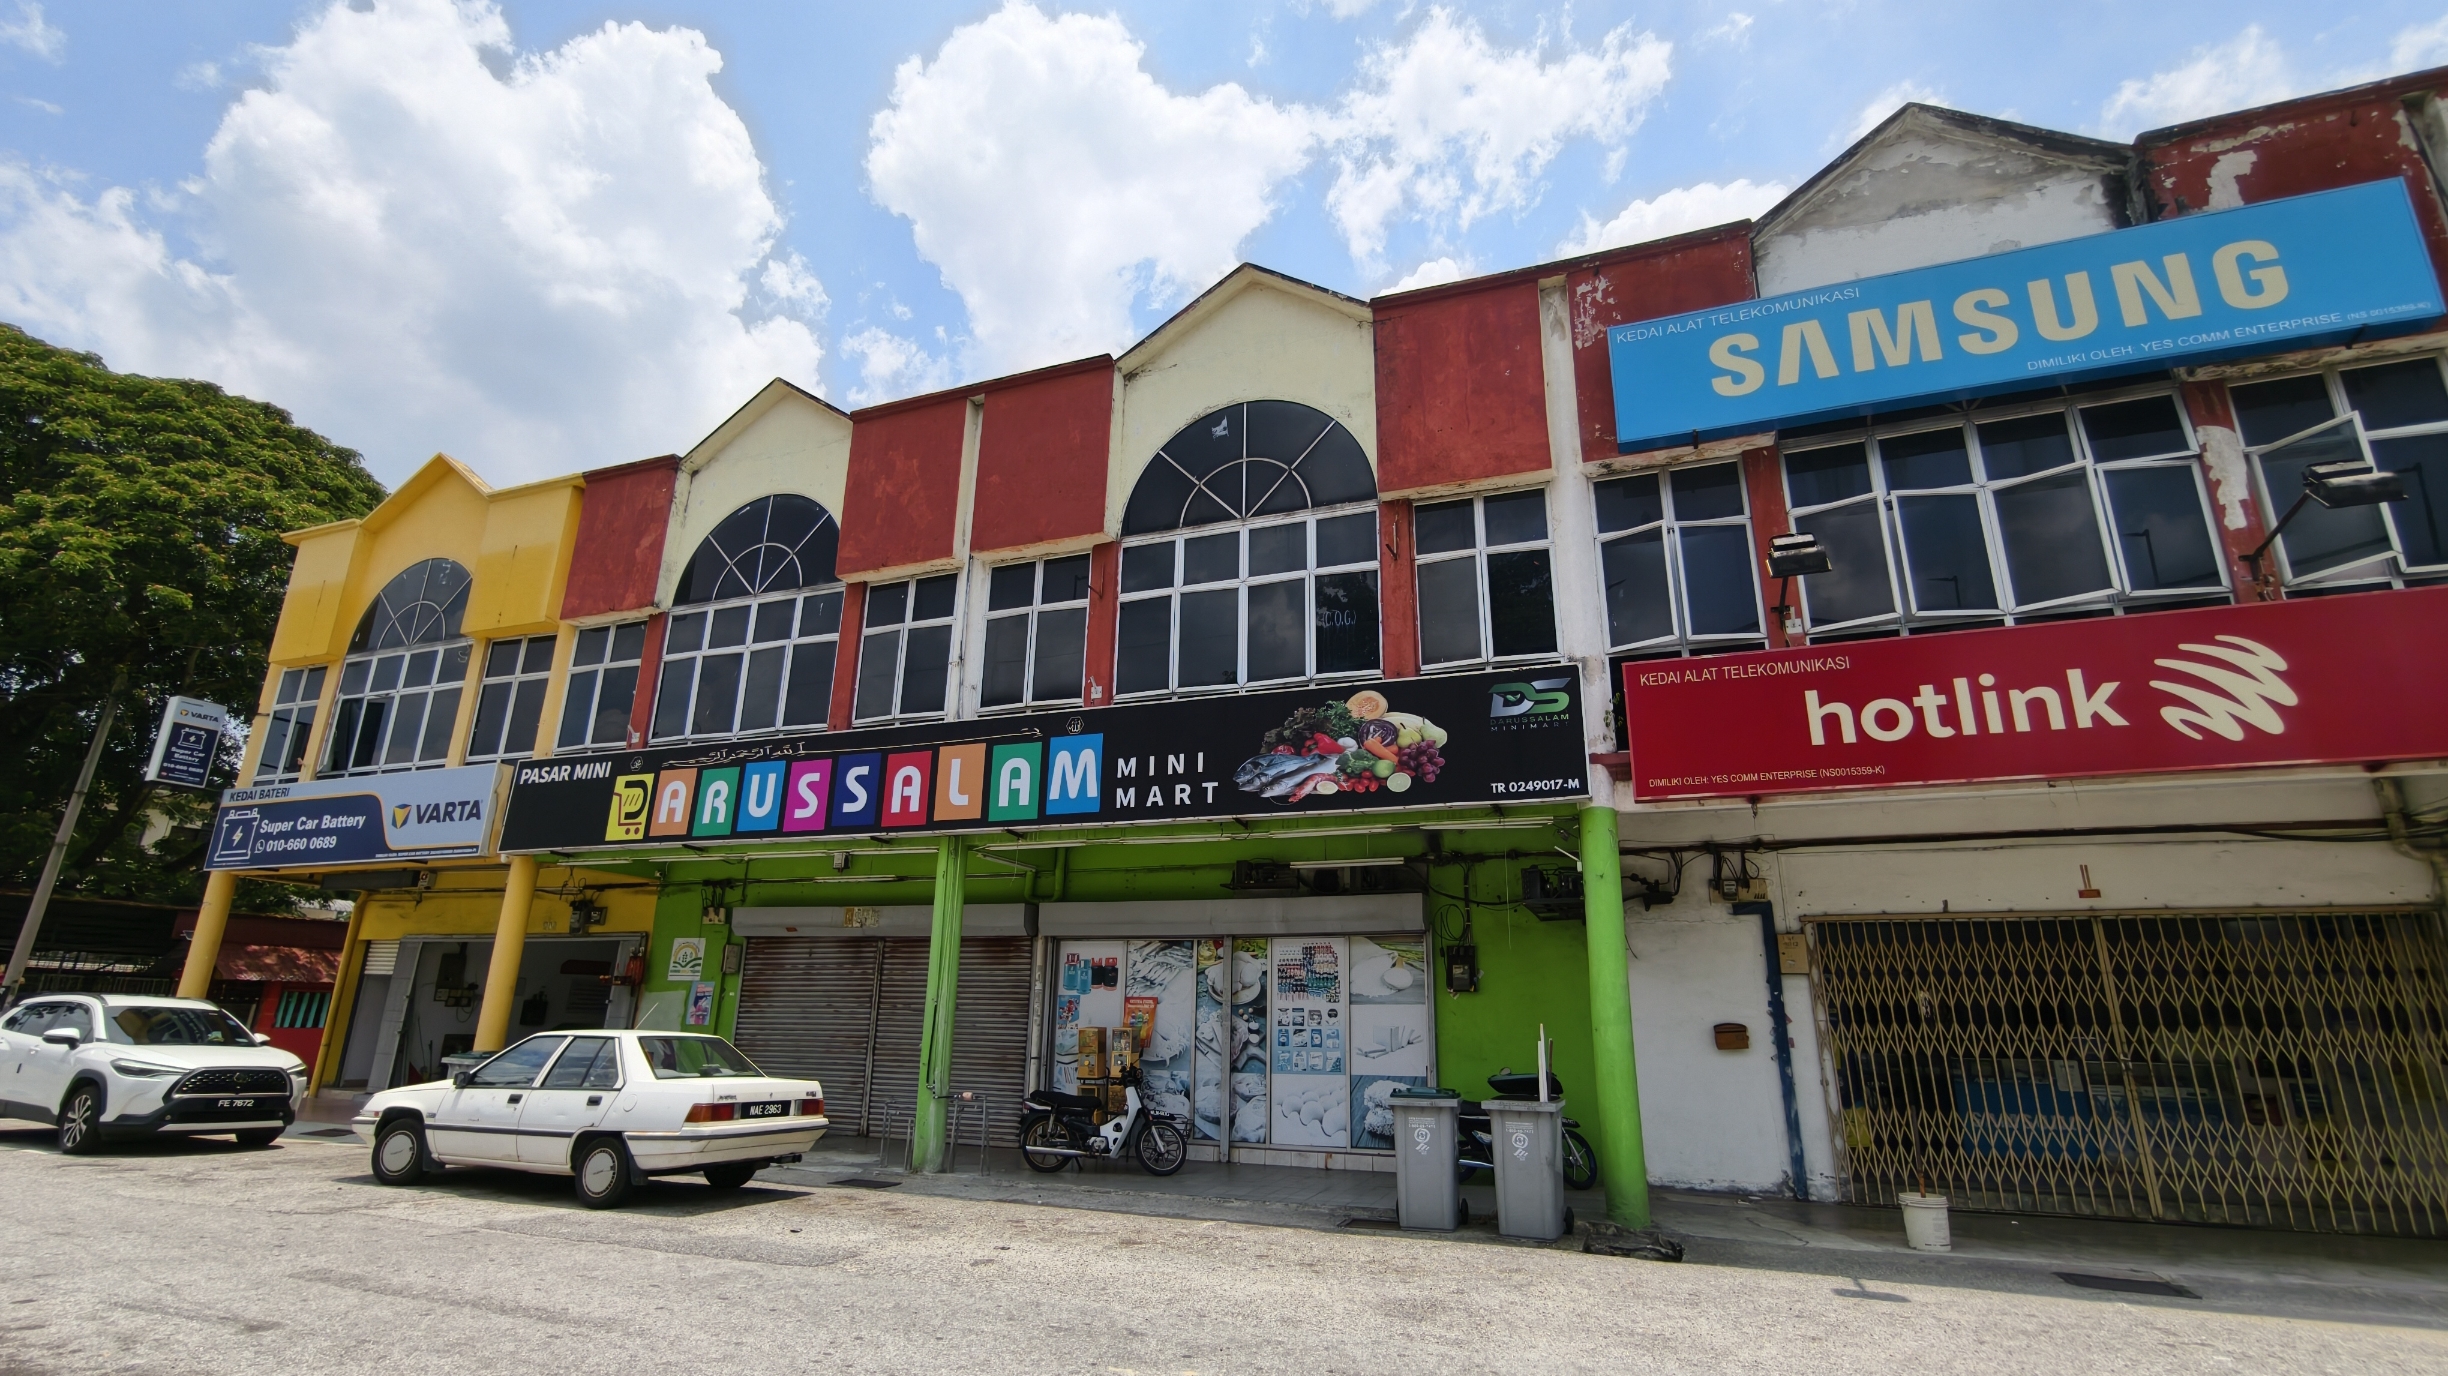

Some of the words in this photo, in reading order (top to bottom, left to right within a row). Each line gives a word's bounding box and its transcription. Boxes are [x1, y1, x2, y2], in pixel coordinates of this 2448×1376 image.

[1617, 325, 1662, 344] KEDAI
[1666, 317, 1705, 336] ALAT
[1709, 287, 1860, 327] TELEKOMUNIKASI
[1708, 239, 2290, 398] SAMSUNG
[2027, 353, 2086, 371] DIMILIKI
[2141, 338, 2174, 352] YES
[2177, 329, 2230, 347] COMM
[2234, 312, 2343, 338] ENTERPRISE
[1639, 671, 1680, 687] KEDAI
[1684, 667, 1718, 683] ALAT
[1722, 655, 1850, 680] TELEKOMUNIKASI
[190, 711, 219, 723] VARTA
[1490, 713, 1569, 726] DARUSSALAM
[1804, 668, 2131, 746] hotlink
[519, 764, 571, 785] PASAR
[573, 761, 612, 781] MINI
[1116, 752, 1204, 779] MINI
[613, 748, 1099, 826] DARUSSALAM
[1490, 783, 1506, 794] TR
[1508, 778, 1580, 793] 0249017-M
[1649, 778, 1682, 788] DIMILIKI
[1684, 776, 1709, 786] OLEH:
[1711, 774, 1729, 784] YES
[1730, 772, 1758, 783] COMM
[1760, 769, 1818, 781] ENTERPRISE
[229, 791, 257, 802] KEDAI
[259, 787, 290, 800] BATERI
[1115, 781, 1219, 809] MART
[260, 819, 294, 835] Super
[297, 816, 318, 831] Car
[321, 814, 366, 829] Battery
[416, 799, 481, 825] VARTA
[266, 837, 307, 852] 010-660
[309, 836, 337, 849] 0689
[749, 1104, 762, 1116] NAE
